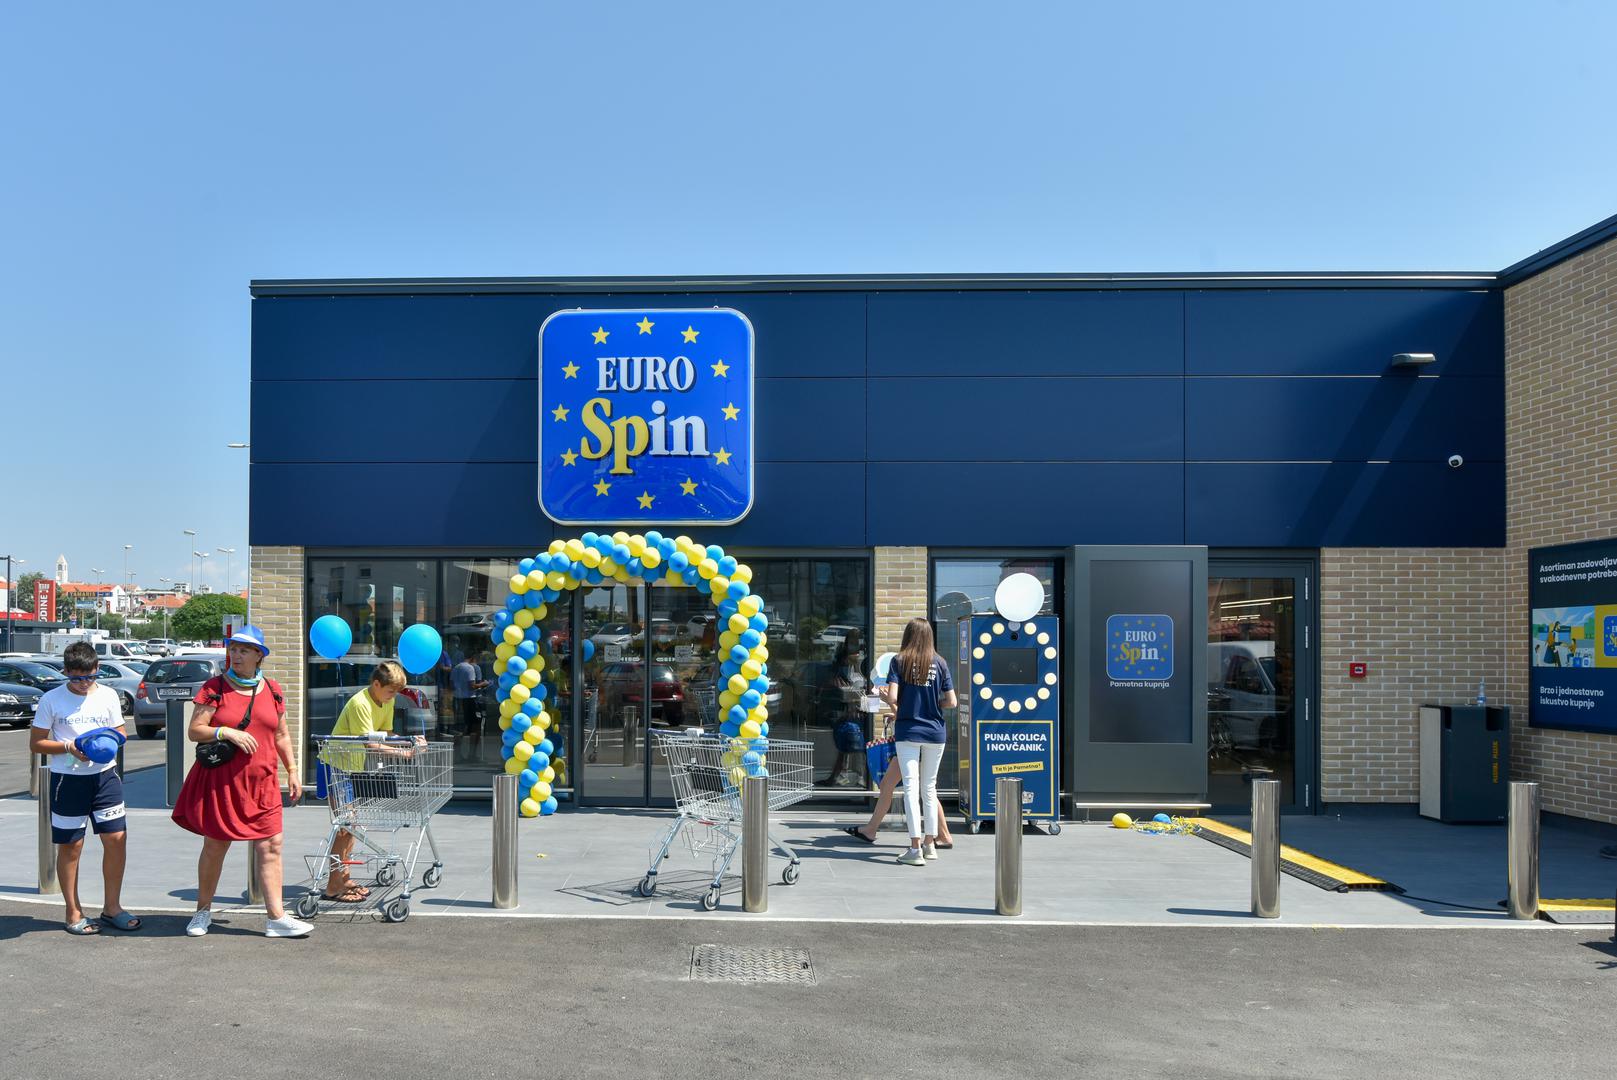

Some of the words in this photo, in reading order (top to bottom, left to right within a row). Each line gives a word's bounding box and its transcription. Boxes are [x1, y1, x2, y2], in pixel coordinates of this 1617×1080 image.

[596, 356, 696, 393] EURO
[580, 397, 712, 476] Spin
[1540, 562, 1576, 573] Asortiman
[1540, 573, 1587, 583] svakodnevne
[1587, 569, 1617, 582] potrebe
[1125, 630, 1156, 642] EURO
[1119, 642, 1159, 665] Spin
[1144, 681, 1170, 689] kupnja
[1540, 686, 1555, 694] Brzo
[1558, 686, 1604, 697] jednostavno
[1540, 696, 1569, 706] iskustvo
[1569, 698, 1595, 710] kupnje
[984, 733, 1011, 741] PUNA
[1012, 733, 1047, 741] KOLICA
[991, 741, 1045, 751] NOVČANIK.
